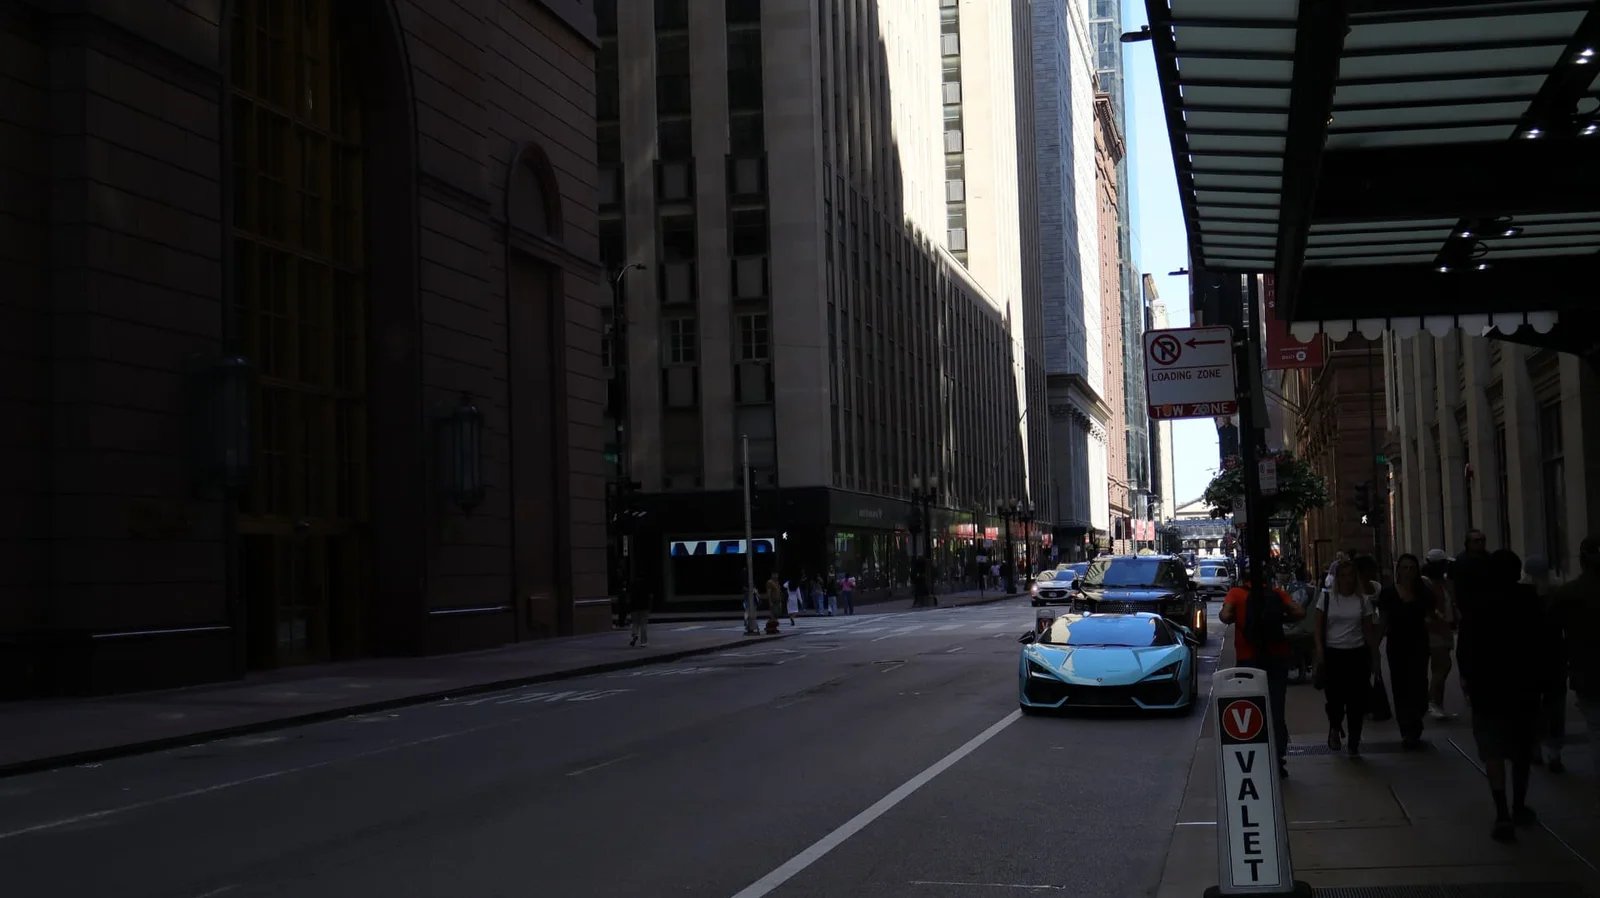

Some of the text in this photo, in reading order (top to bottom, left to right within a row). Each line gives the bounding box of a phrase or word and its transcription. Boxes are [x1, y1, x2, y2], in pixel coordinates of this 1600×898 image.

[1151, 369, 1222, 382] LOADING ZONE
[1153, 402, 1229, 417] TOW ZONE
[1231, 708, 1253, 733] V
[1235, 750, 1263, 882] VALET
